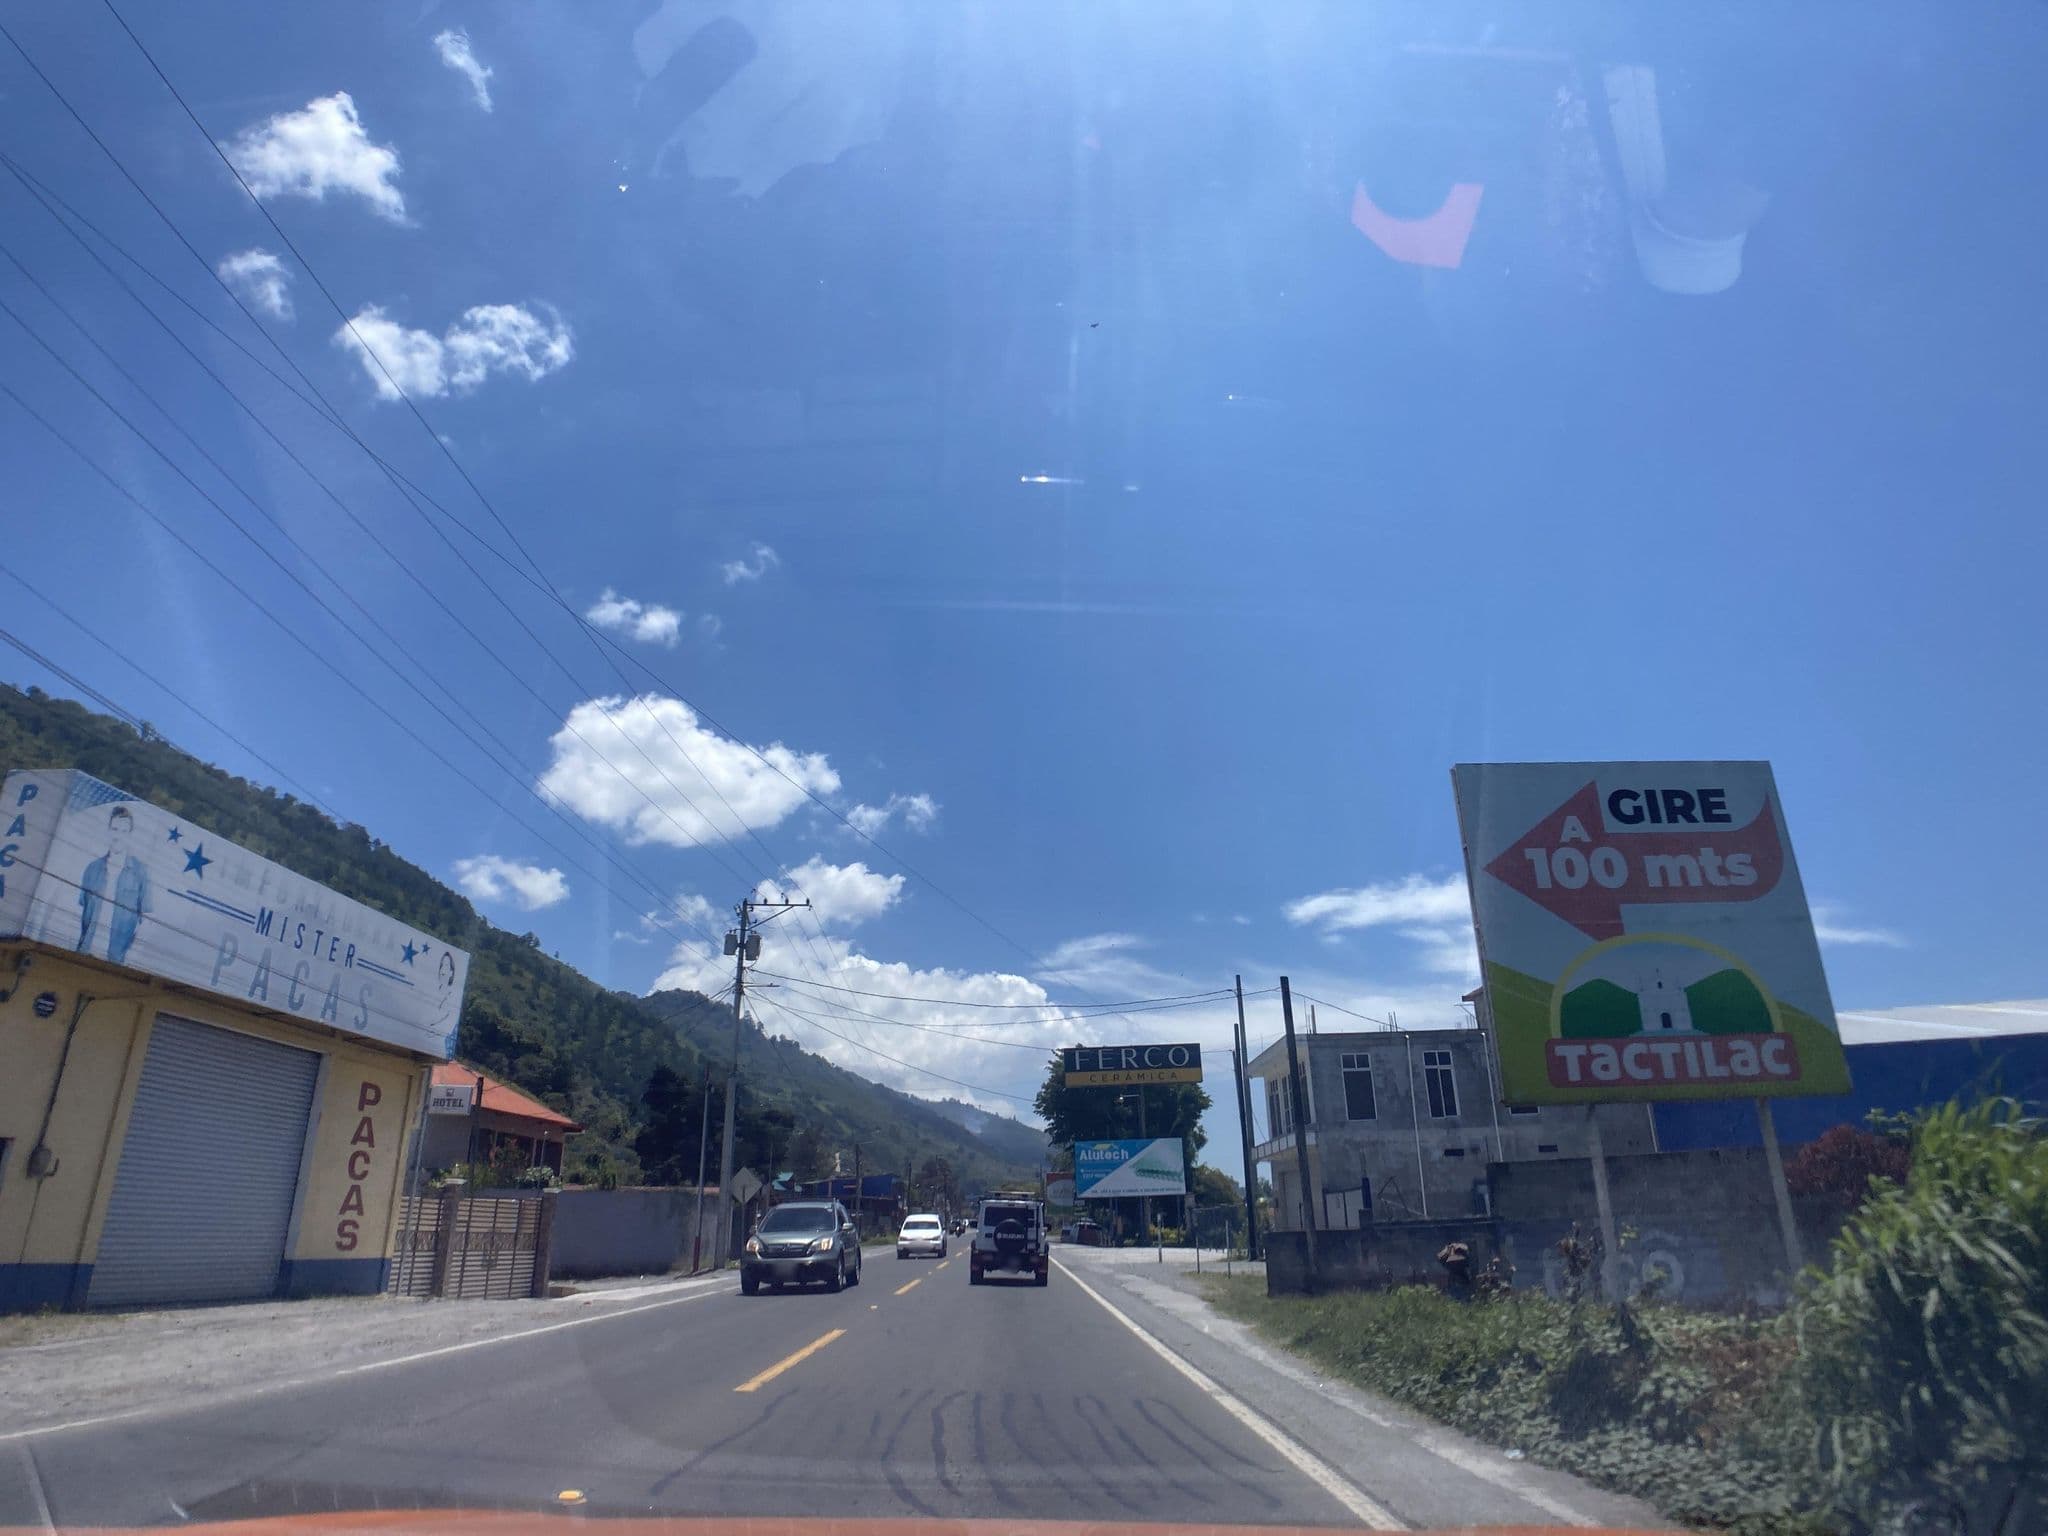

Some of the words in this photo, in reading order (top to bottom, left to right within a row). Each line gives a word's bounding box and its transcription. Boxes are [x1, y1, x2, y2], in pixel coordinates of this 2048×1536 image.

[1607, 788, 1732, 825] GIRE
[0, 783, 39, 898] PAC
[1560, 815, 1592, 843] A
[1524, 846, 1629, 890] 100
[1644, 847, 1758, 888] mts
[255, 906, 356, 969] MISTER
[210, 932, 373, 1030] PACAS
[1074, 1046, 1190, 1071] FERCO
[432, 1097, 464, 1108] HOTEL
[336, 1081, 382, 1252] PACAS
